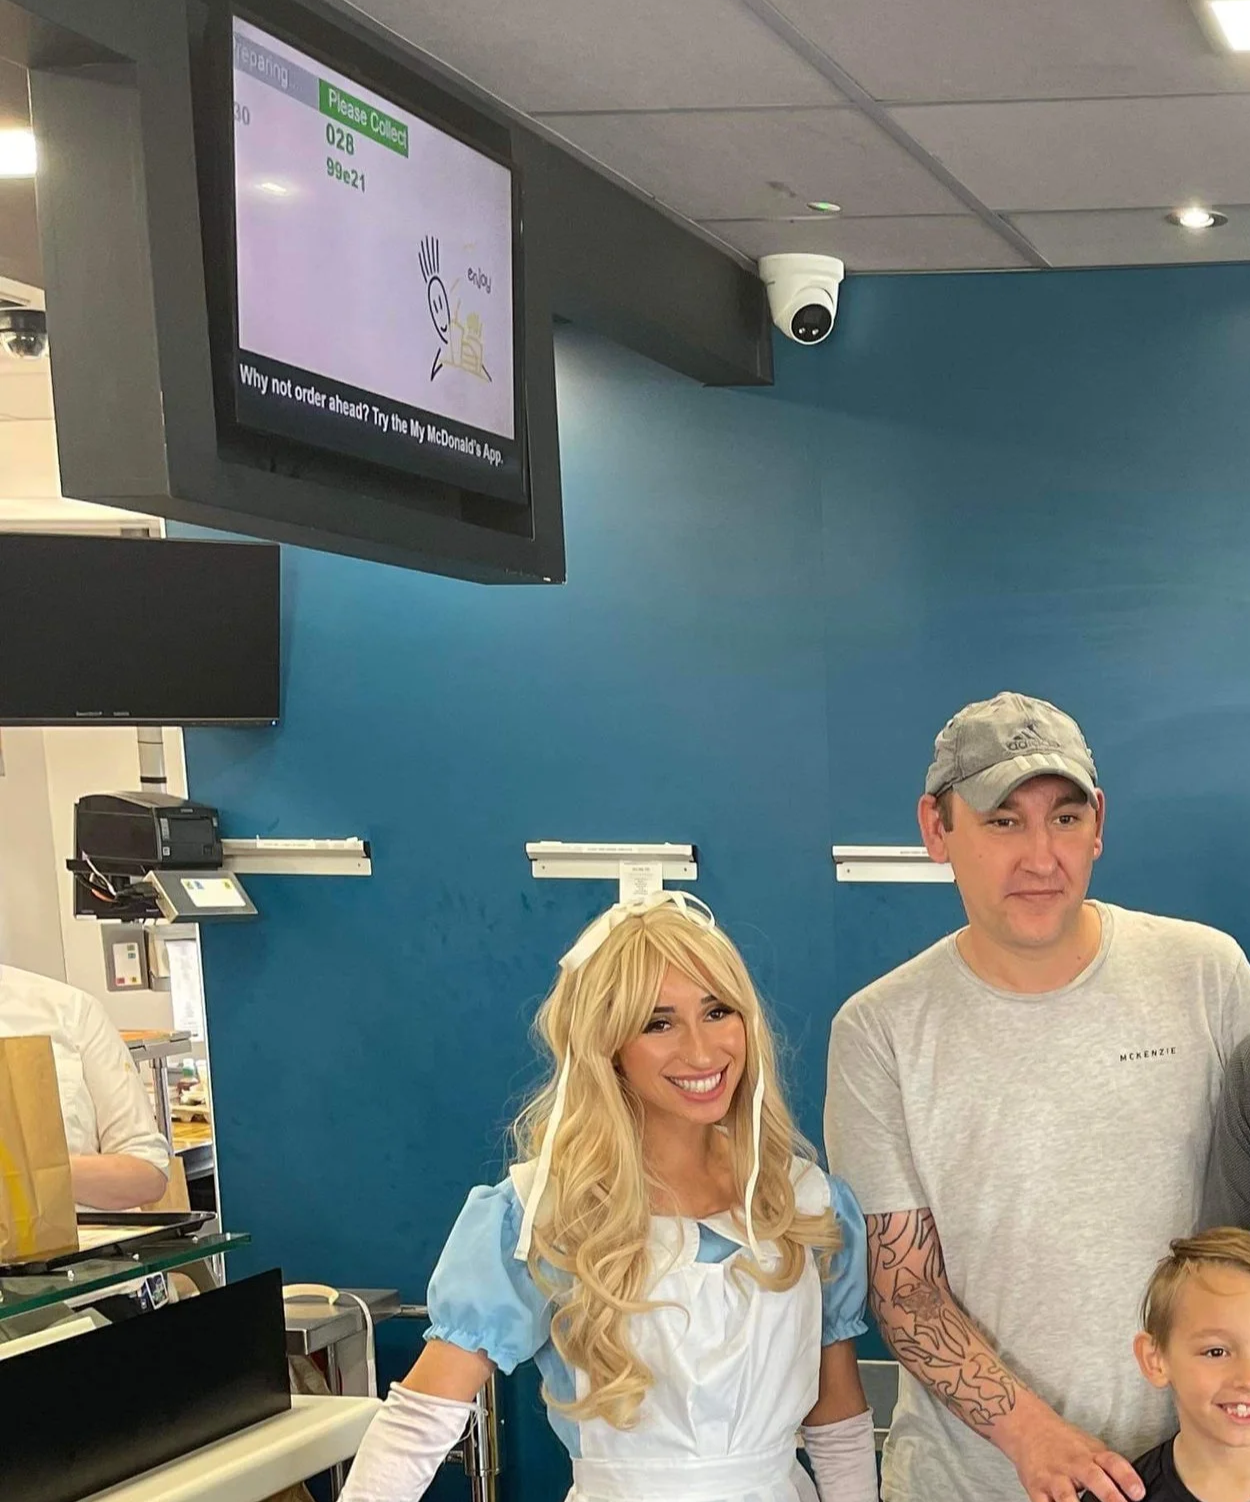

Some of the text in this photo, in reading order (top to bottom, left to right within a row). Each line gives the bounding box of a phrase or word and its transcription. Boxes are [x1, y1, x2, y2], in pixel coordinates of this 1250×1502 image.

[328, 87, 408, 149] Please Collect
[326, 122, 355, 156] 028
[326, 157, 366, 193] 99e21
[467, 266, 492, 294] enjoy
[239, 363, 504, 467] Why not order ahead? Try the My McDonald's App.
[1119, 1046, 1176, 1061] MCKENZIE
